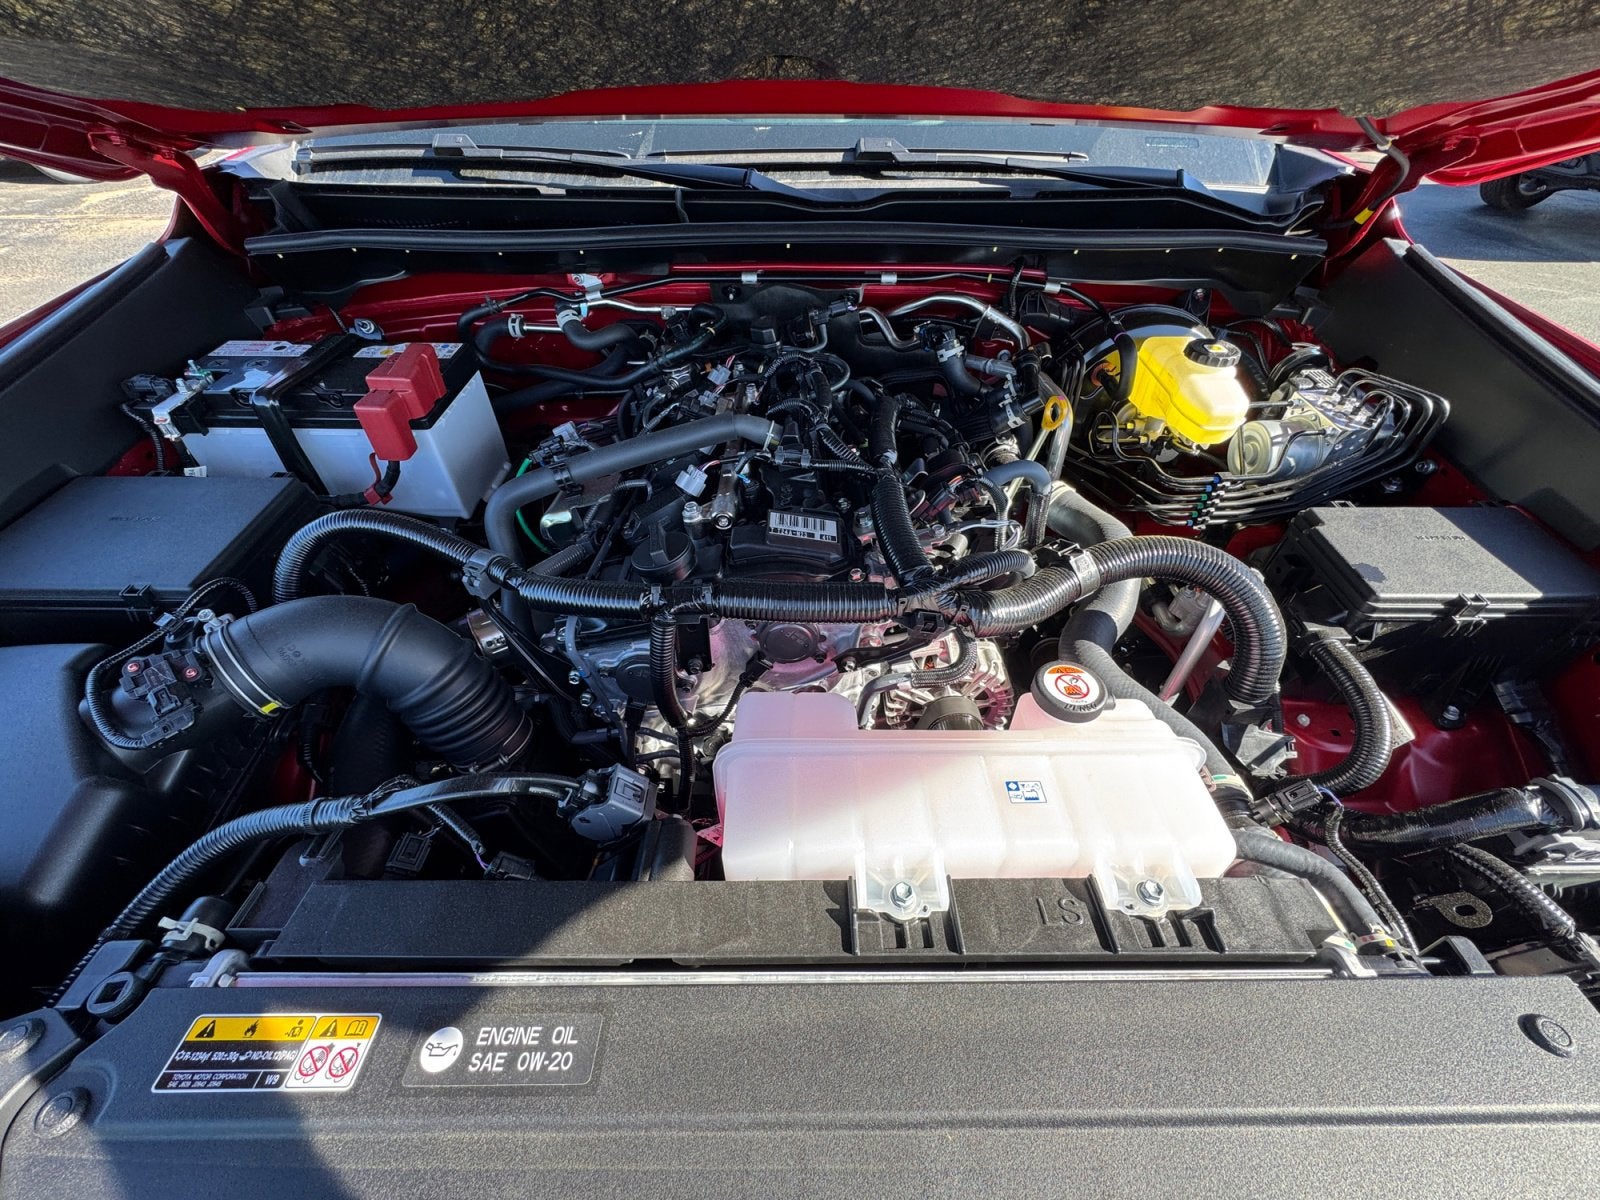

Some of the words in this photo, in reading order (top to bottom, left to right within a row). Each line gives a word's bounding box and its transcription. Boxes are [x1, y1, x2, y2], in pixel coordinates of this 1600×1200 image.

[476, 1026, 542, 1046] ENGINE
[552, 1026, 578, 1045] OIL
[468, 1051, 508, 1072] SAE
[517, 1051, 574, 1071] 0W-20
[264, 1074, 280, 1086] W9
